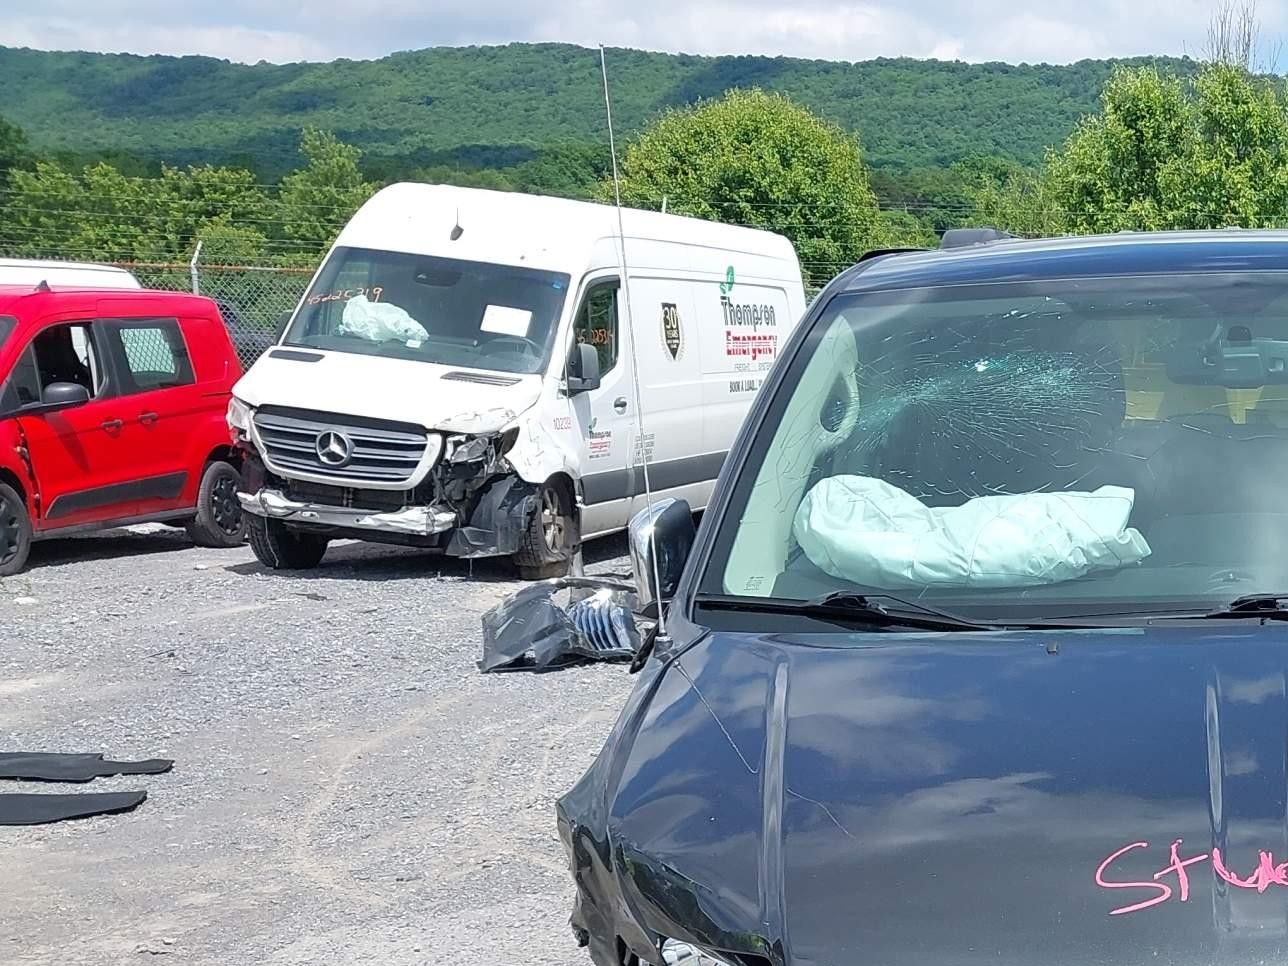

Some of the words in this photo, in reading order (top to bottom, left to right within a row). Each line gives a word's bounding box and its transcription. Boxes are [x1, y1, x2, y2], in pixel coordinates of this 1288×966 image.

[663, 306, 677, 329] 30
[720, 296, 777, 332] Thompson
[725, 330, 777, 360] Emergency
